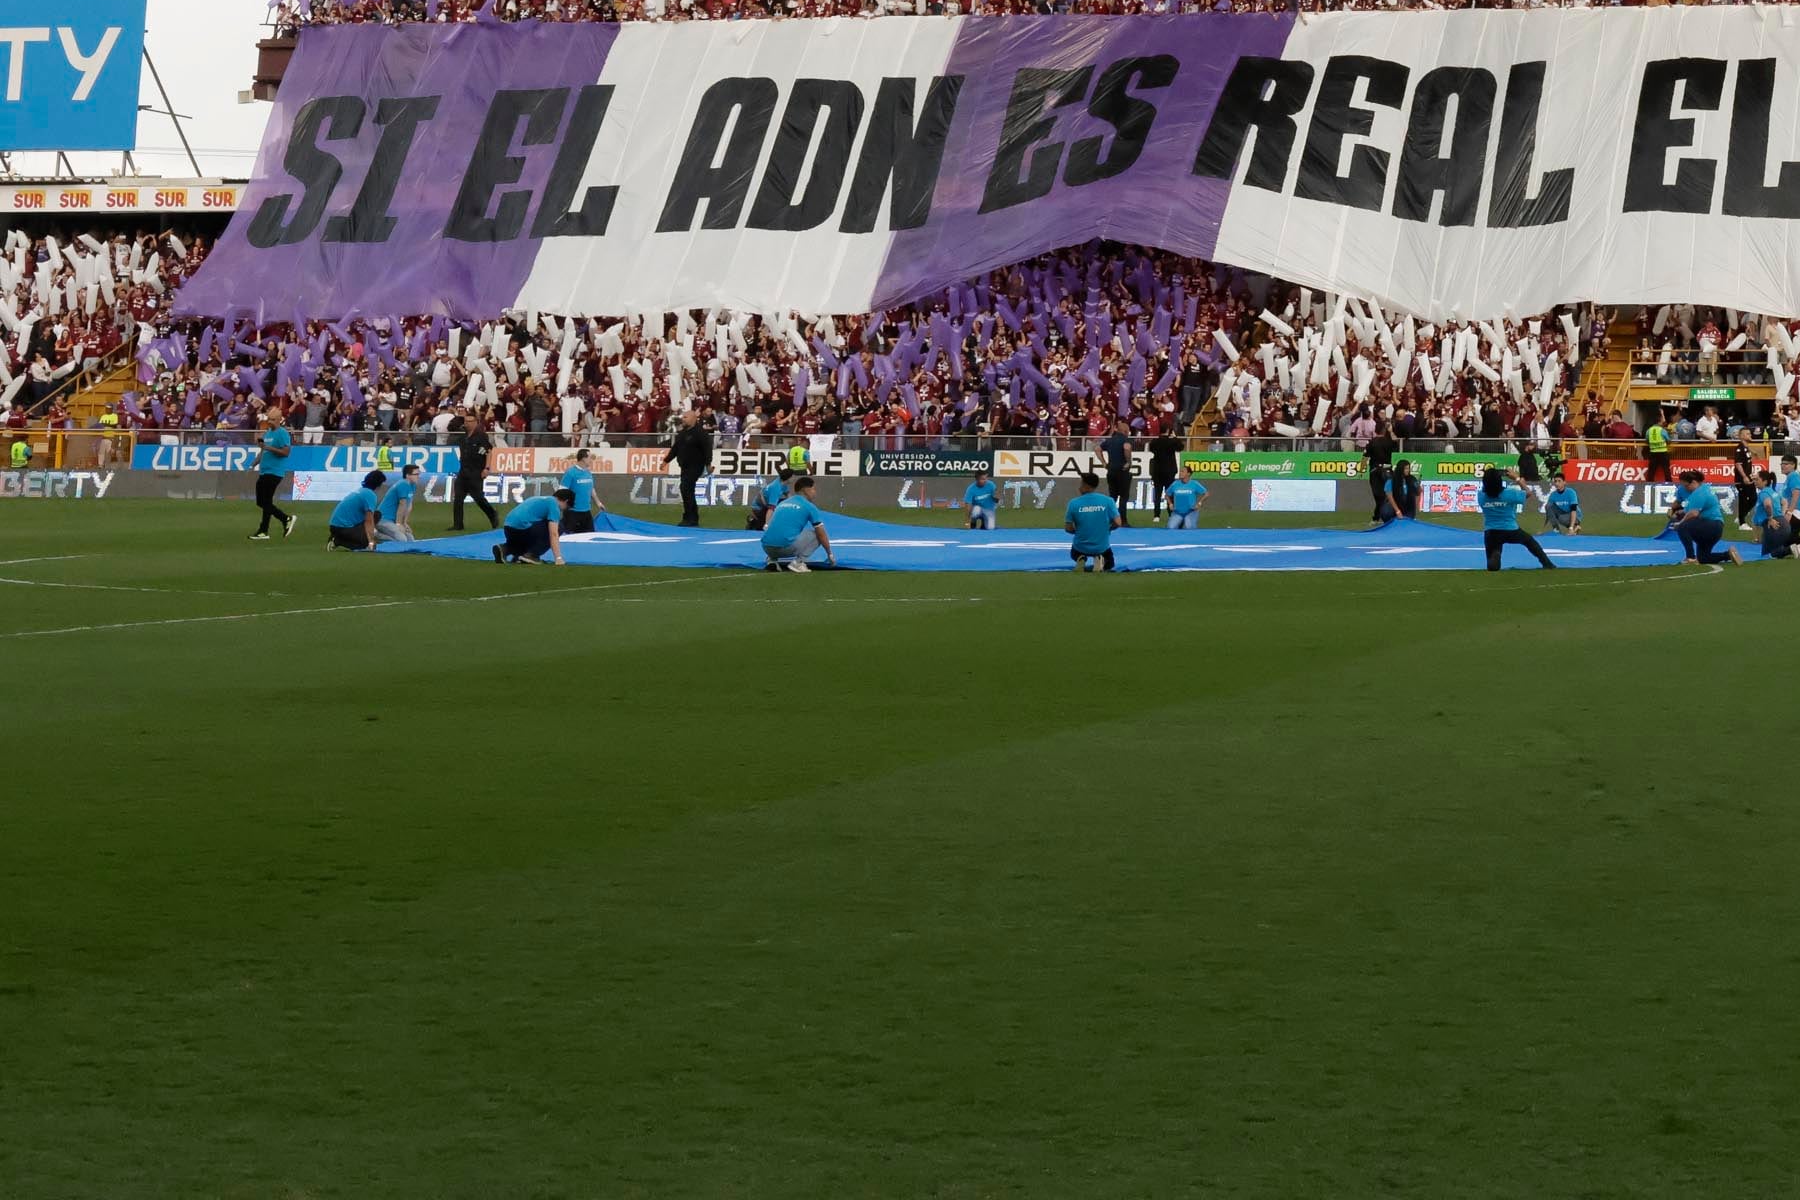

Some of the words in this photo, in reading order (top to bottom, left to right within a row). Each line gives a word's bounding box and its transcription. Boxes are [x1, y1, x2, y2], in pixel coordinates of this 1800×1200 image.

[247, 94, 443, 250] SI
[442, 84, 619, 242] EL
[655, 75, 965, 234] ADN
[978, 54, 1180, 214] ES
[1192, 55, 1575, 229] REAL
[14, 193, 43, 208] SUR
[59, 192, 89, 208] SUR
[106, 192, 137, 207] SUR
[154, 192, 185, 207] SUR
[202, 191, 233, 207] SUR
[496, 450, 531, 471] CAFÉ
[880, 461, 933, 471] CASTRO
[936, 461, 988, 471] CARAZO
[1184, 461, 1240, 476] monge
[1576, 462, 1648, 481] Tioflex
[1710, 467, 1722, 475] sin
